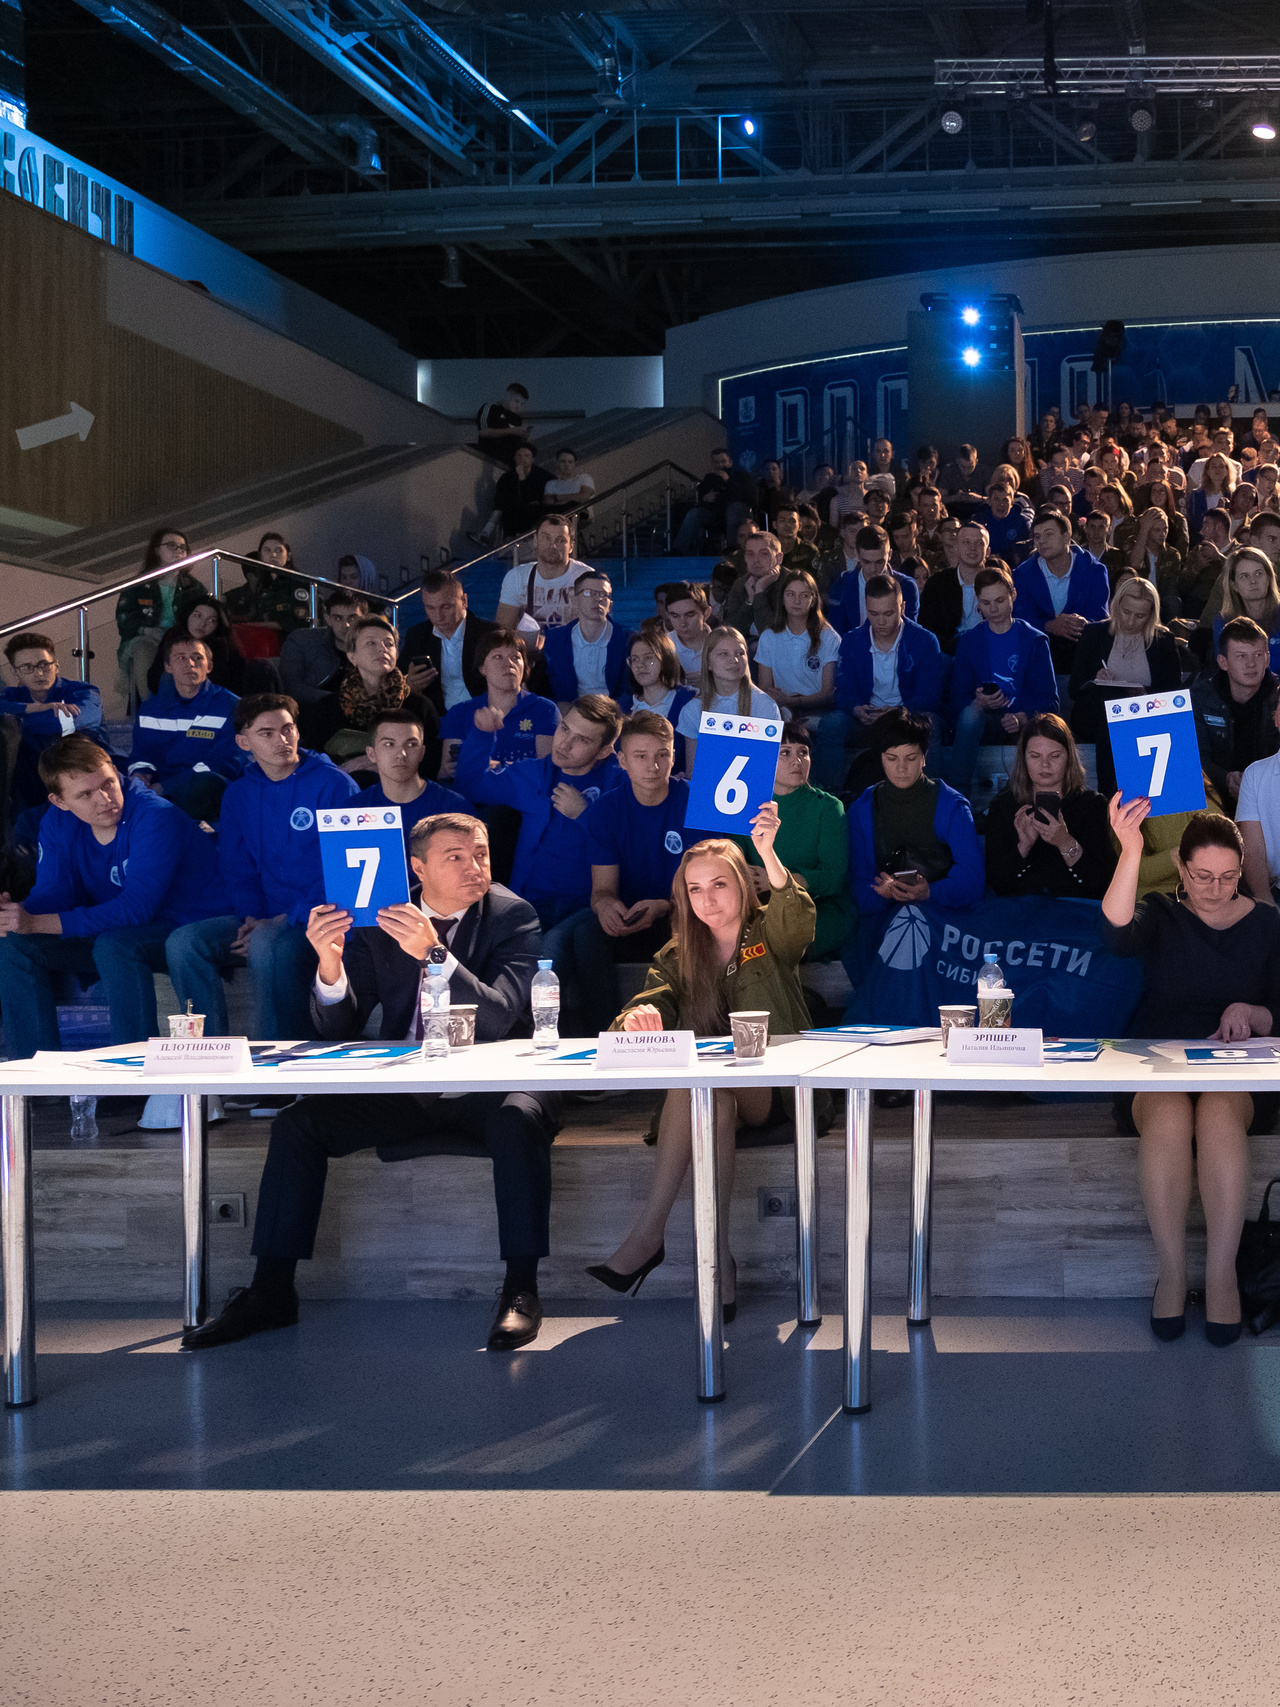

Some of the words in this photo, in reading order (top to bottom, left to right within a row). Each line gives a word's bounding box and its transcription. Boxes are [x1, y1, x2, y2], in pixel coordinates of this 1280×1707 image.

[714, 755, 750, 815] 6
[1136, 732, 1172, 798] 7
[345, 847, 381, 909] 7
[941, 923, 1093, 977] РОССЕТИ
[161, 1043, 232, 1051] ПЛОТНИКОВ
[614, 1035, 676, 1044] МАЛЯНОВА
[646, 1046, 677, 1054] Юрьевна
